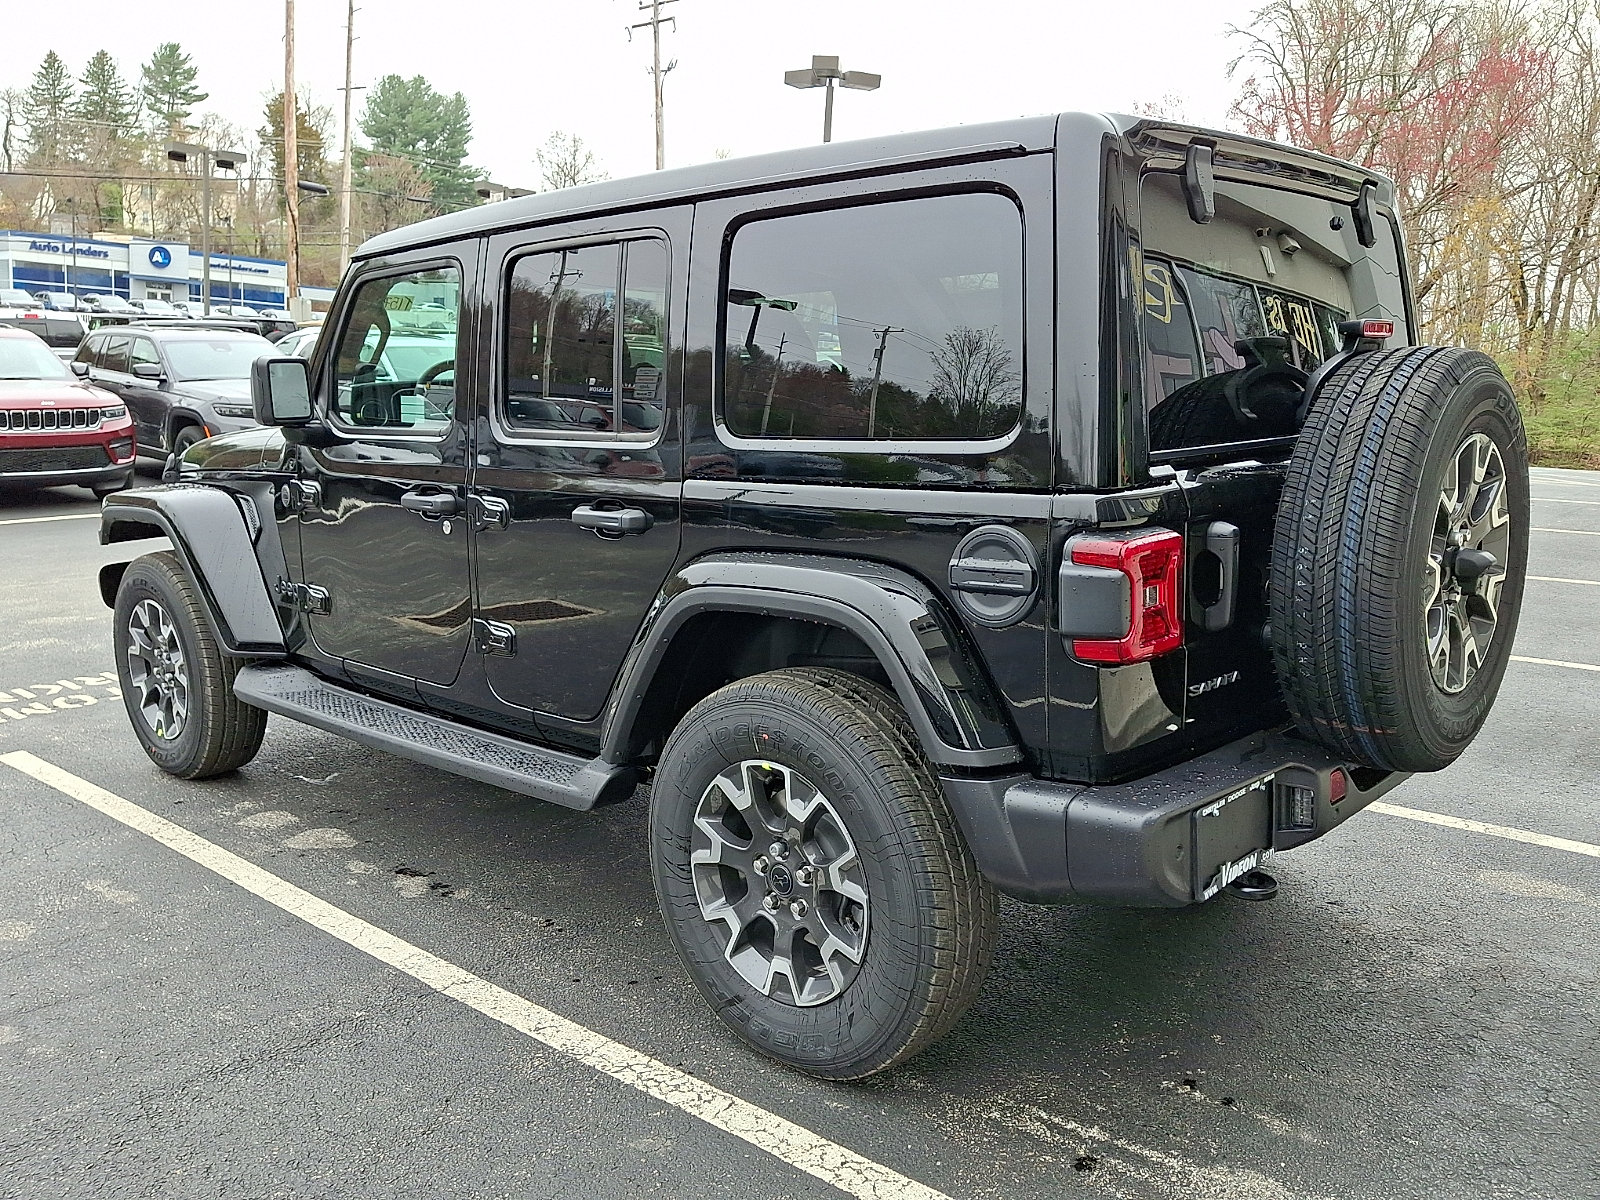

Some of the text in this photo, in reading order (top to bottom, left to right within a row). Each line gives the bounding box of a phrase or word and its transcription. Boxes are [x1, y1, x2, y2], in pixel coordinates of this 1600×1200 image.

[29, 240, 109, 258] Auto Lenders
[1188, 670, 1242, 697] SAHARA
[677, 722, 864, 815] BRIDGESTONE
[1227, 787, 1247, 803] DODGE
